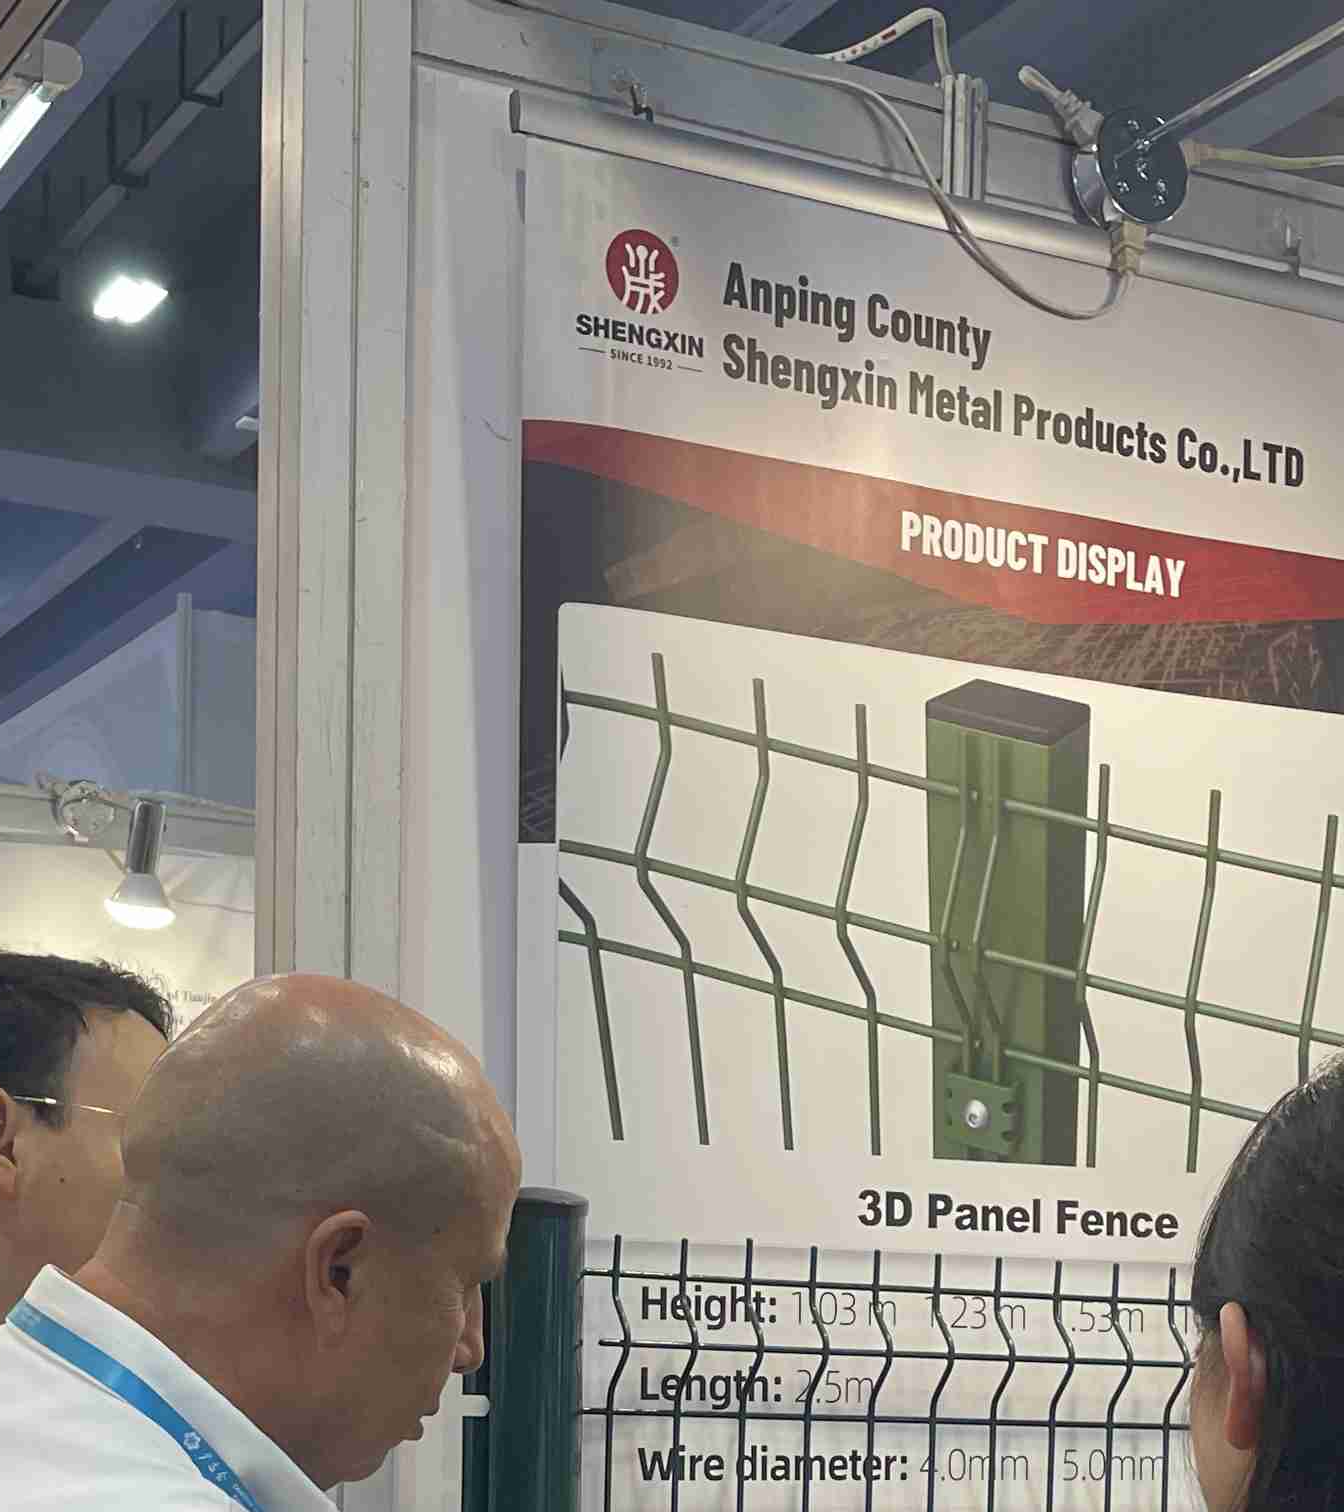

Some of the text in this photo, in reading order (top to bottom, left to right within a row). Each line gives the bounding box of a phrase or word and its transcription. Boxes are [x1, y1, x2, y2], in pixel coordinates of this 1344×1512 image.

[576, 314, 704, 358] SHENGXIN
[723, 262, 992, 370] Anping County
[610, 349, 673, 370] SINCE 1992
[722, 333, 1305, 487] Shengxin Metal Products Co.,LTD
[901, 511, 1186, 598] PRODUCT DISPLAY
[857, 1189, 1179, 1239] 3D Panel Fence
[641, 1285, 777, 1330] Height:
[640, 1366, 782, 1410] Length:
[638, 1445, 724, 1481] Wire
[736, 1445, 908, 1481] diameter:
